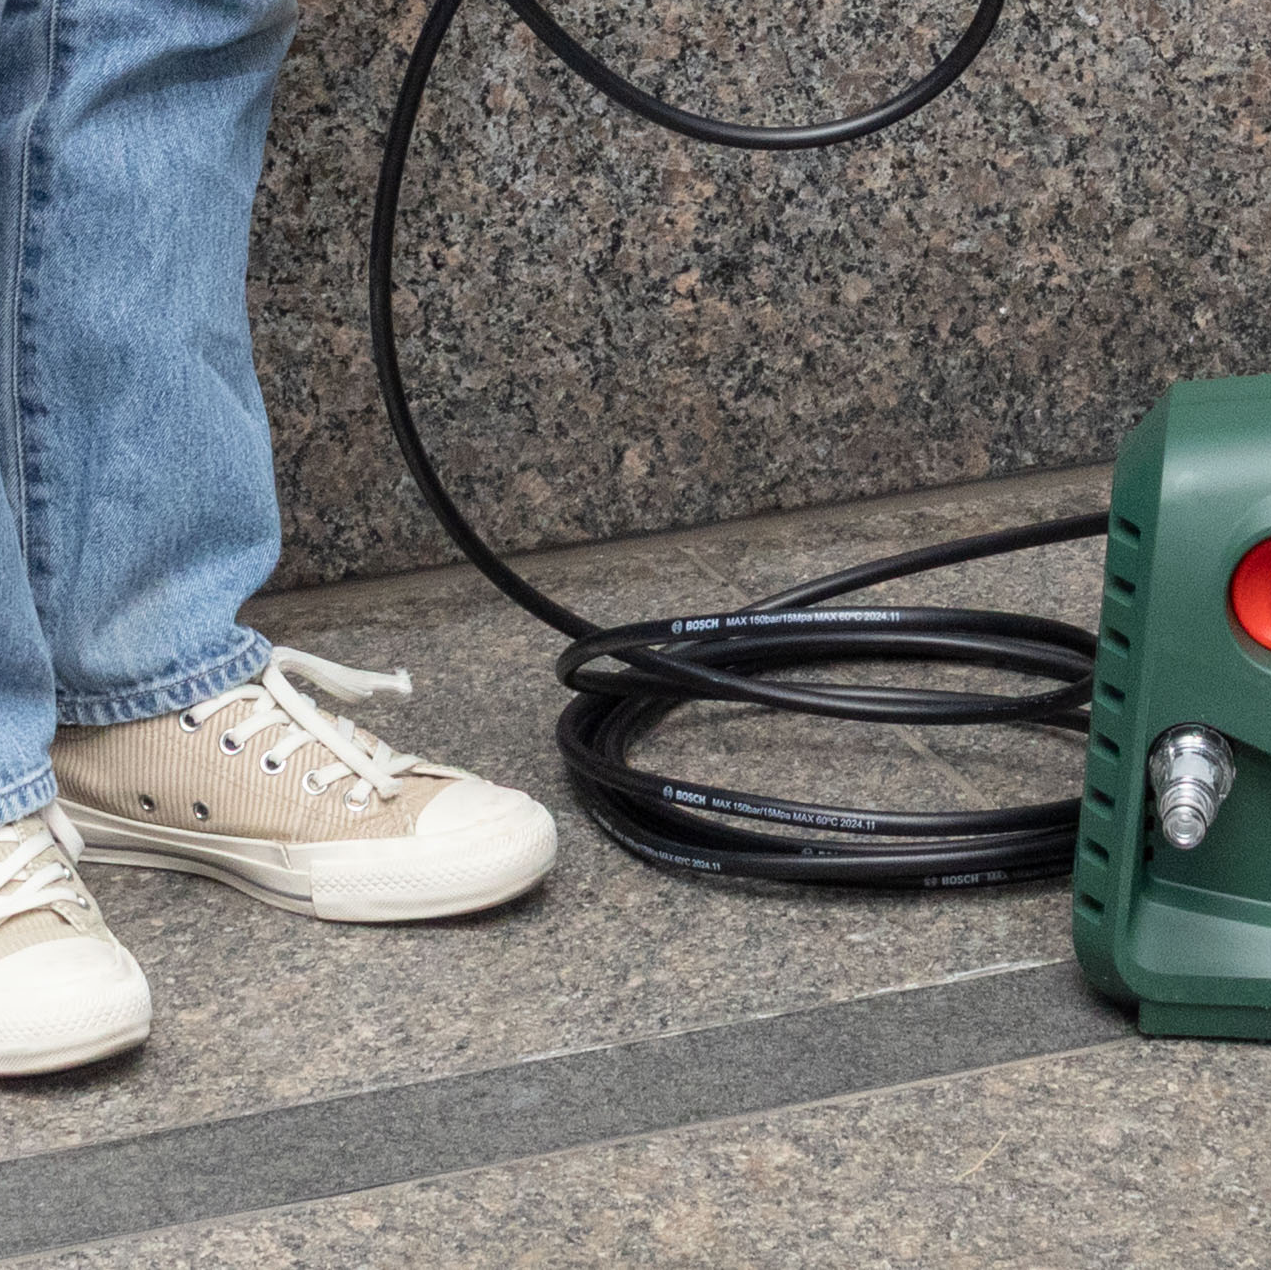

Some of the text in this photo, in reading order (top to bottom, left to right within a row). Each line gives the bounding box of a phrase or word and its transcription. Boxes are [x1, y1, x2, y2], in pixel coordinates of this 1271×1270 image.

[685, 618, 719, 631] BOSCH
[726, 617, 747, 627] MAX
[814, 612, 837, 621] MAX
[863, 610, 901, 622] 2024.11
[675, 790, 707, 805] BOSCH
[712, 797, 732, 809] MAX
[793, 812, 815, 824] MAX
[840, 818, 876, 831] 2024.11
[941, 872, 979, 885] BOSCH
